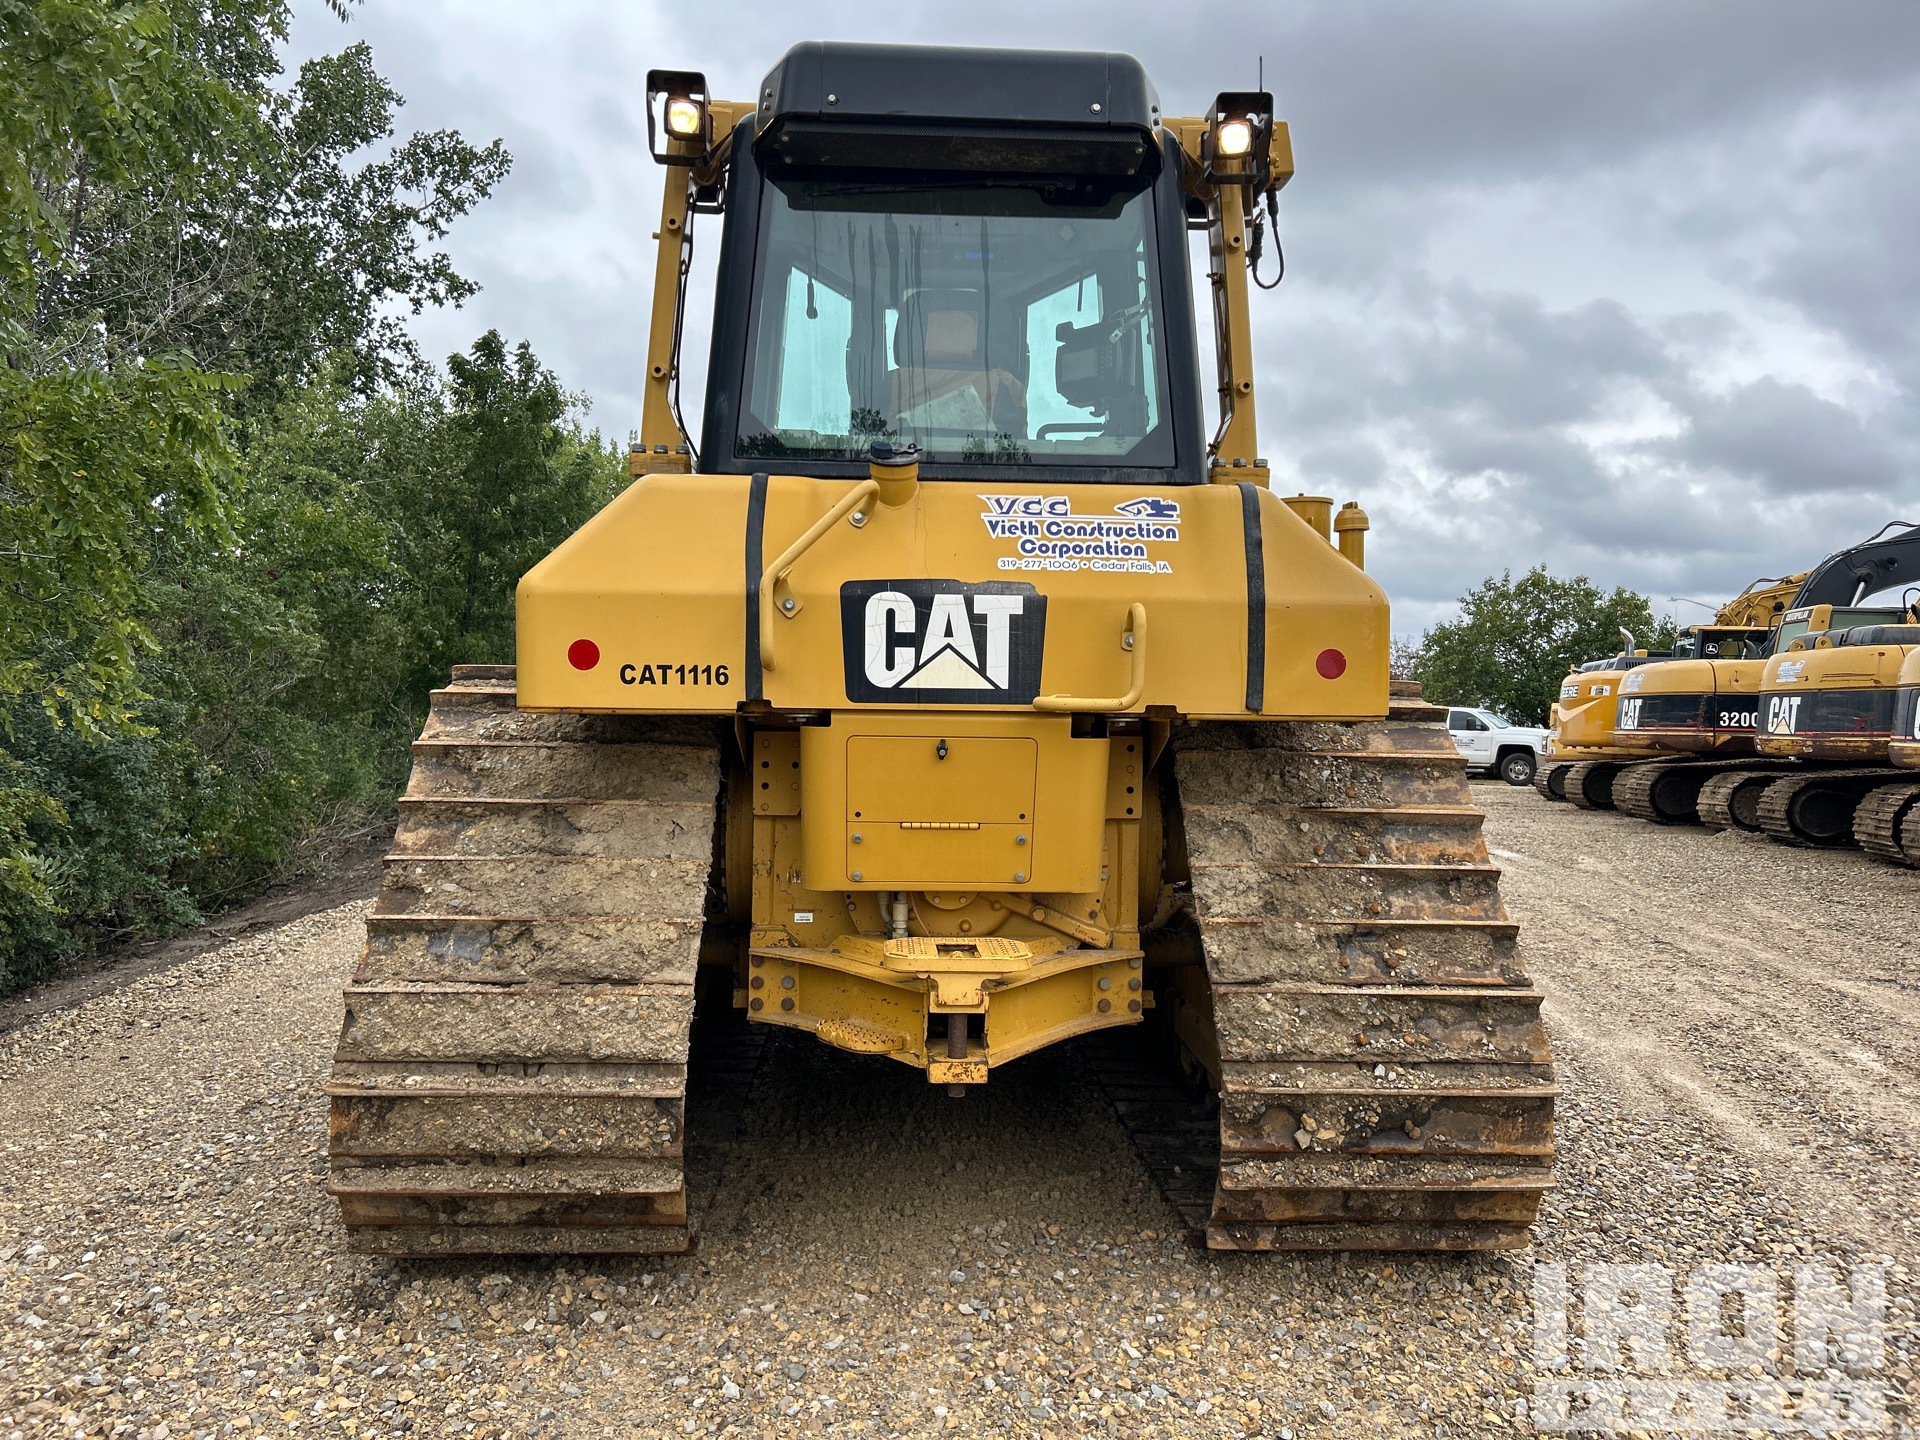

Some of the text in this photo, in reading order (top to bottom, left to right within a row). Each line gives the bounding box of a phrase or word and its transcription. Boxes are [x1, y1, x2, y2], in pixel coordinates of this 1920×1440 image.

[984, 496, 1069, 517] VCC
[986, 519, 1177, 540] Vieth Construction
[1019, 540, 1145, 558] Corporation
[1000, 559, 1170, 573] 319-277-1006 Cedar Falls, IA
[864, 591, 1025, 690] CAT
[620, 663, 730, 686] CAT1116
[1620, 698, 1643, 730] CAT
[1767, 696, 1802, 734] CAT
